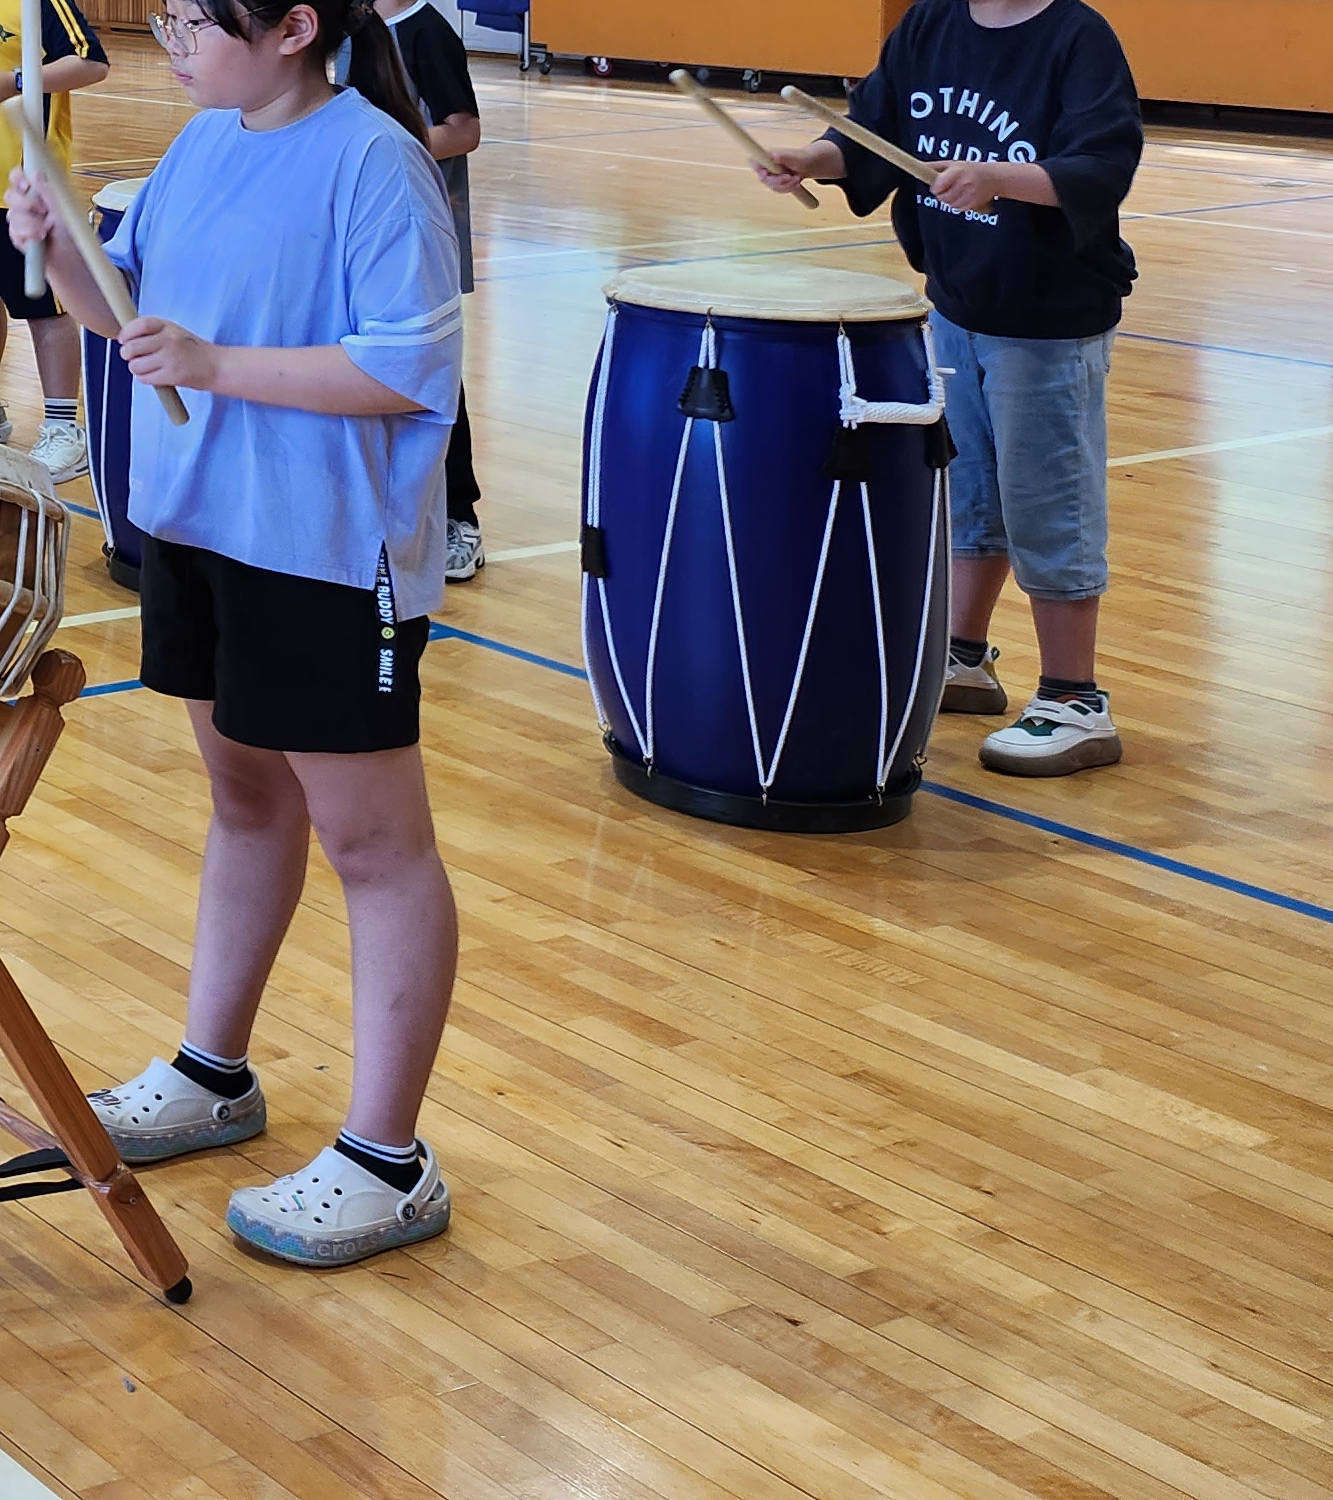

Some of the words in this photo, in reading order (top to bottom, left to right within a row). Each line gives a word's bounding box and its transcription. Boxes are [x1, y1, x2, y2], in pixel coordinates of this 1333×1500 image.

[924, 196, 938, 208] on
[965, 209, 999, 226] good
[377, 585, 394, 625] BUDDY
[378, 649, 394, 686] SMILE
[317, 1236, 378, 1257] crocs
